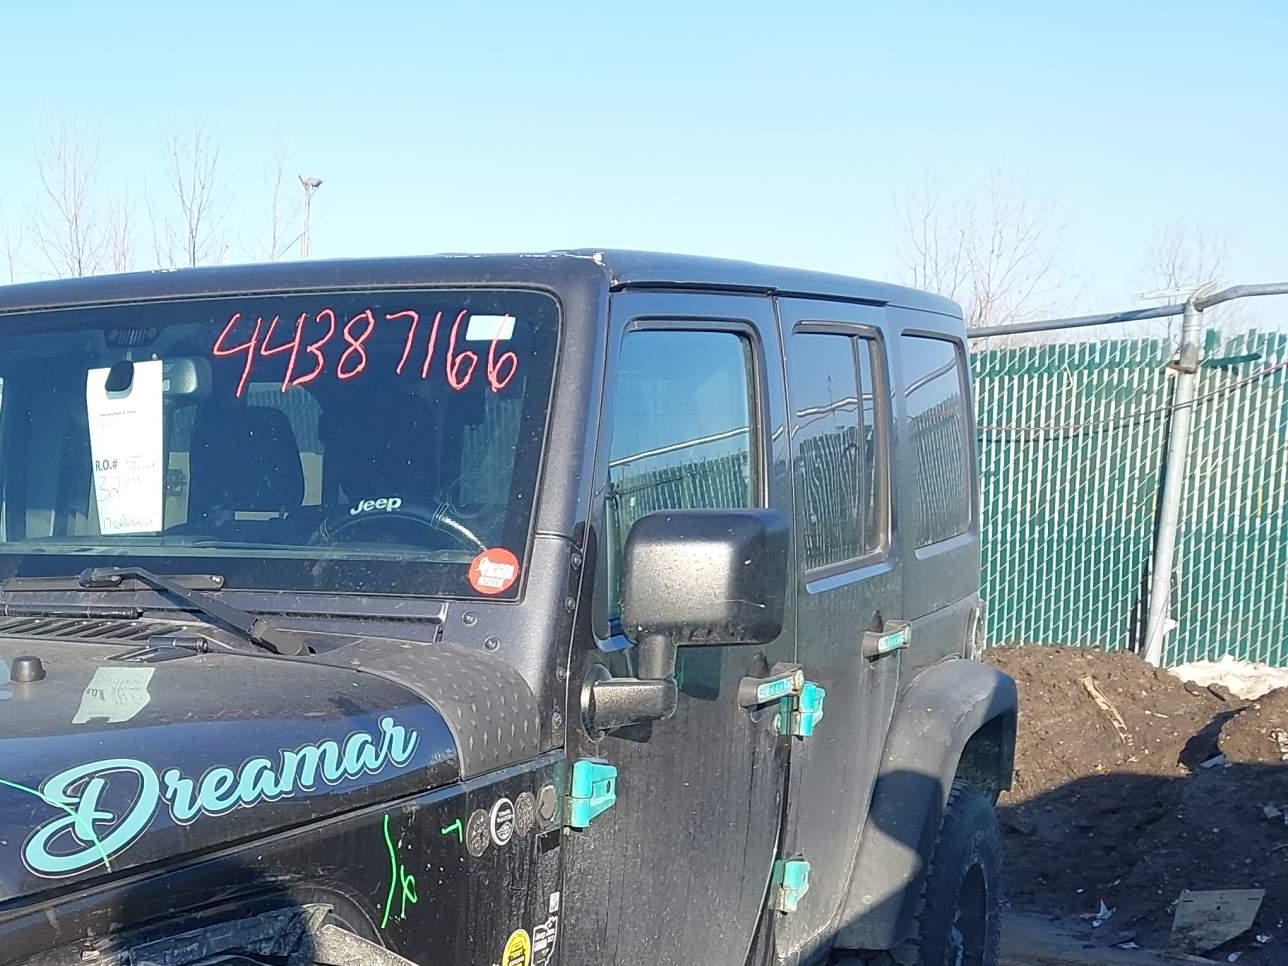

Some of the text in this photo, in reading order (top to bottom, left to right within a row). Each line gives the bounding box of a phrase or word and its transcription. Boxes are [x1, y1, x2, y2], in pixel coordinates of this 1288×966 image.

[212, 307, 519, 398] 44387166
[350, 497, 402, 515] Jeep
[22, 716, 419, 878] Dreamar
